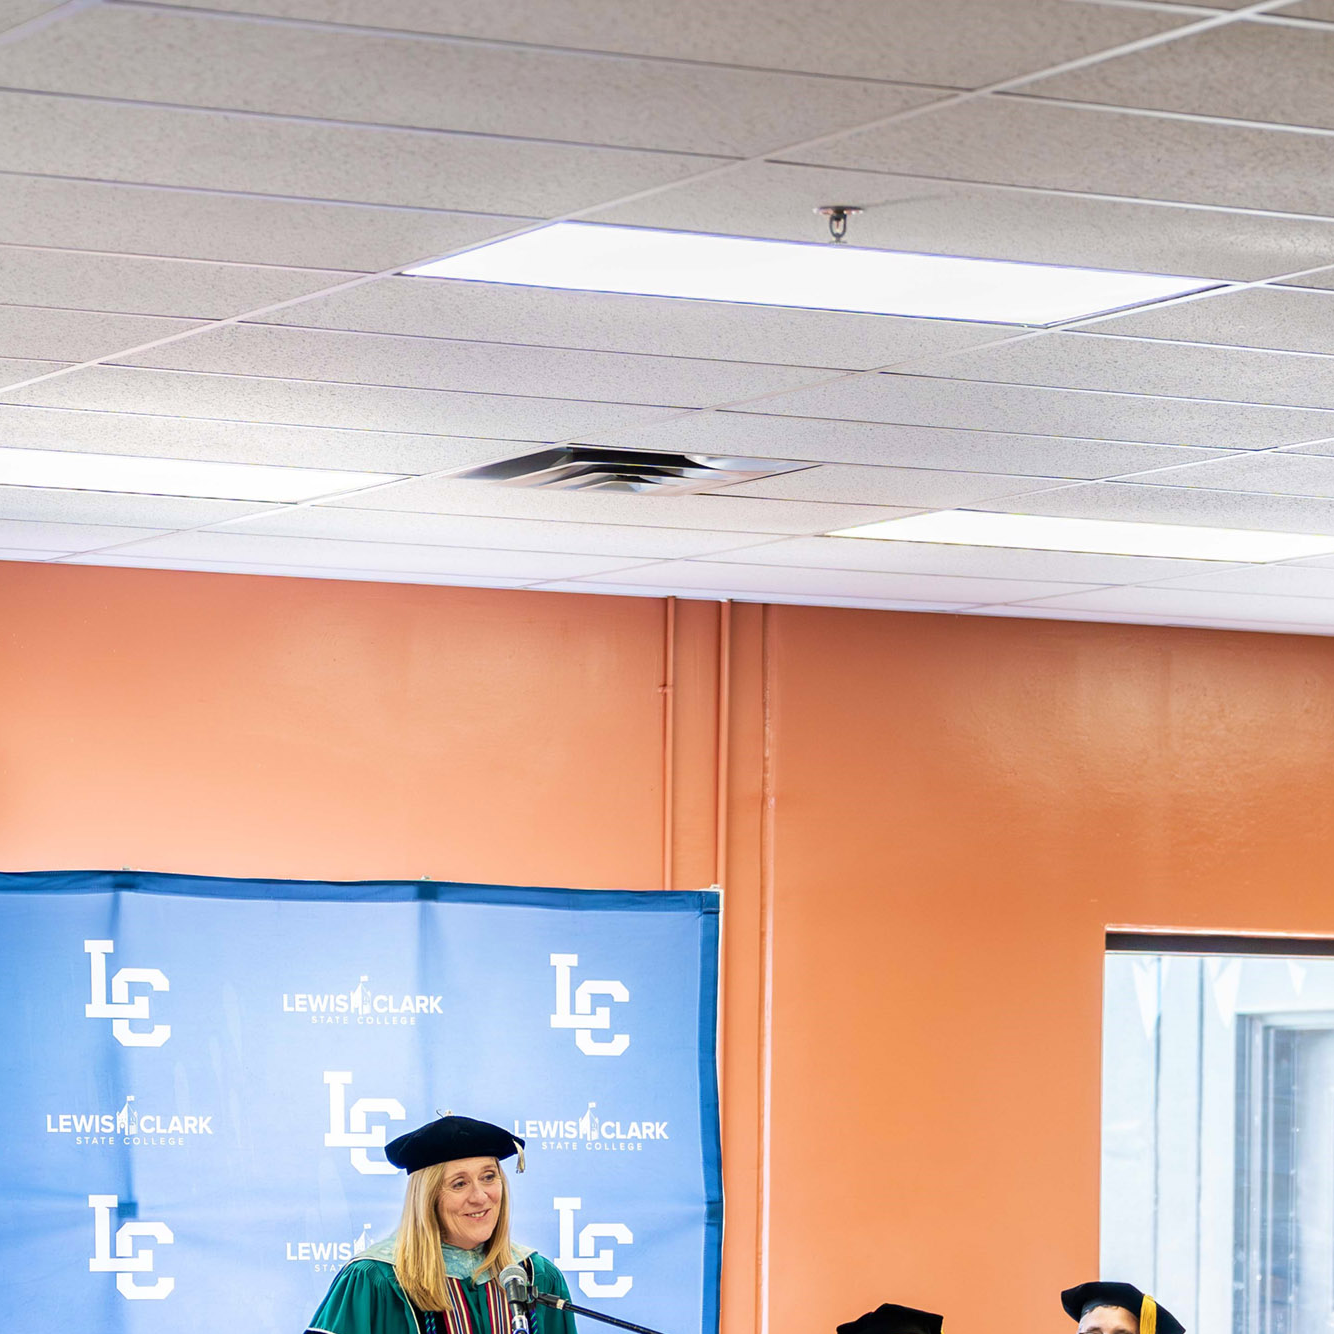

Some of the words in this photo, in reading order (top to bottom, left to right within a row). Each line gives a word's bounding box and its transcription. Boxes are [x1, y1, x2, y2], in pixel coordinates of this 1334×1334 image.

[84, 940, 171, 1047] LC
[282, 993, 349, 1013] LEWIS
[372, 994, 444, 1014] CLARK
[550, 954, 629, 1056] LC
[311, 1015, 348, 1025] STATE
[356, 1015, 417, 1026] COLLEGE
[46, 1114, 115, 1134] LEWIS
[139, 1115, 213, 1135] CLARK
[323, 1071, 405, 1174] LC
[513, 1117, 579, 1141] LEWIS
[600, 1121, 669, 1140] CLARK
[75, 1136, 115, 1145] STATE
[122, 1136, 186, 1147] COLLEGE
[541, 1141, 578, 1151] STATE
[585, 1141, 642, 1151] COLLEGE
[89, 1195, 175, 1300] LC
[286, 1242, 352, 1261] LEWIS
[553, 1197, 634, 1298] LC
